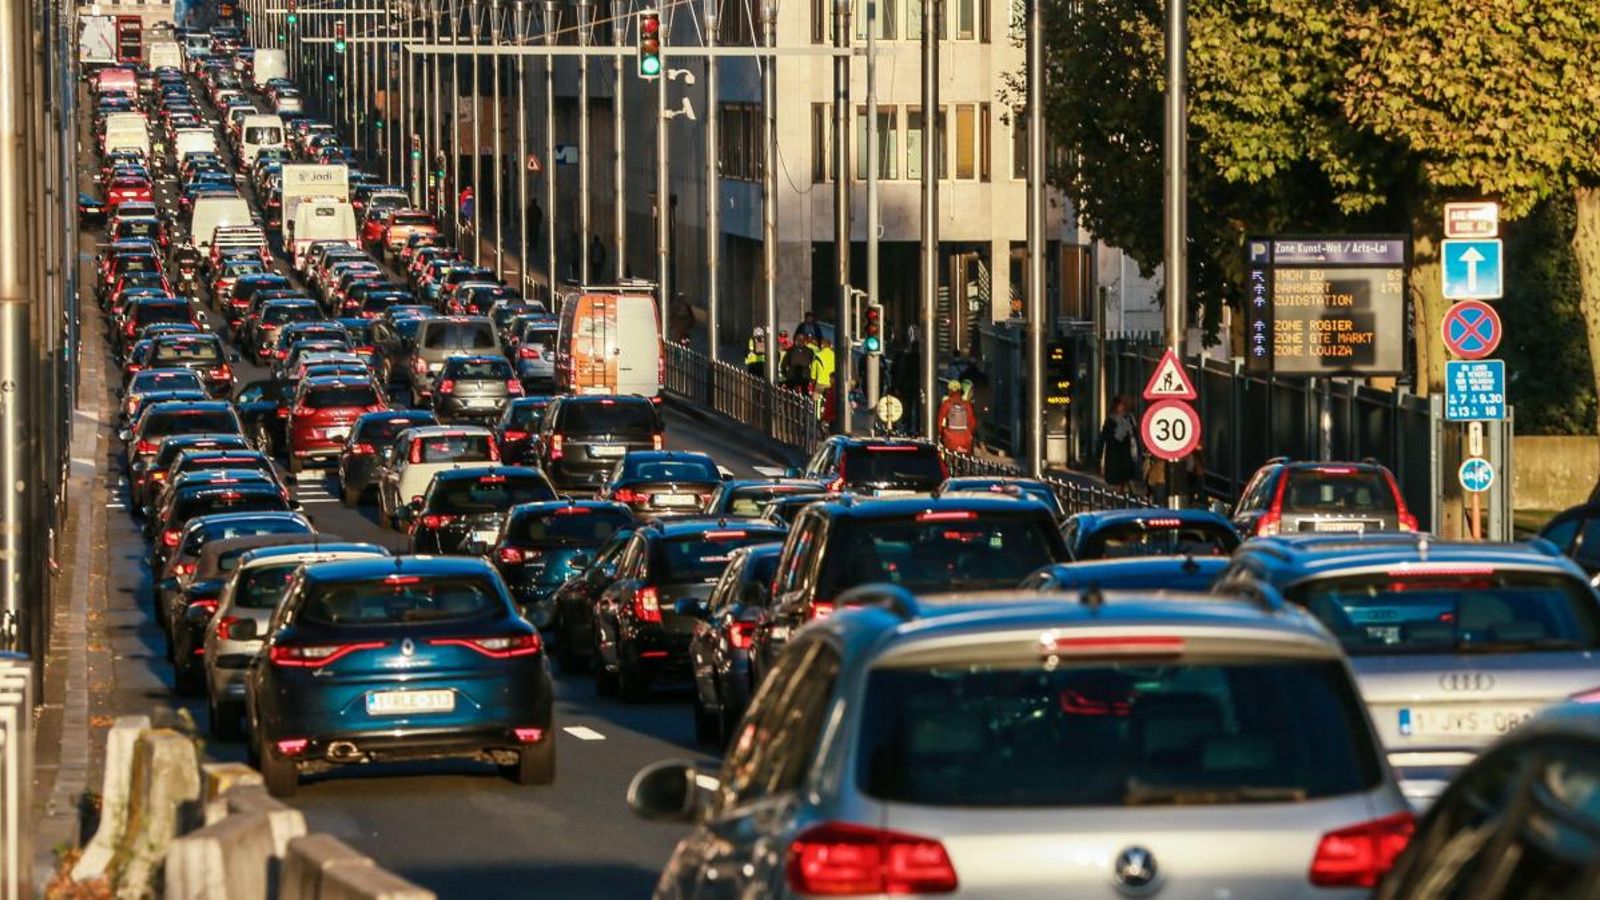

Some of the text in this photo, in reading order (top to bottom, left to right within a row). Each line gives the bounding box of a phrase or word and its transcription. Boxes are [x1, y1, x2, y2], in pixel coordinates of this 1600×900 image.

[1252, 243, 1266, 261] P
[1275, 243, 1295, 253] Zone
[1274, 295, 1352, 306] ZUIDSTATION
[1274, 320, 1352, 331] ZONE ROGIER
[1274, 333, 1374, 343] ZONE GTE MARKT
[1274, 345, 1352, 356] ZONE LOUIZA
[1460, 394, 1468, 404] 7
[1479, 393, 1502, 404] 9.30
[1458, 406, 1470, 417] 13
[1156, 419, 1186, 441] 30
